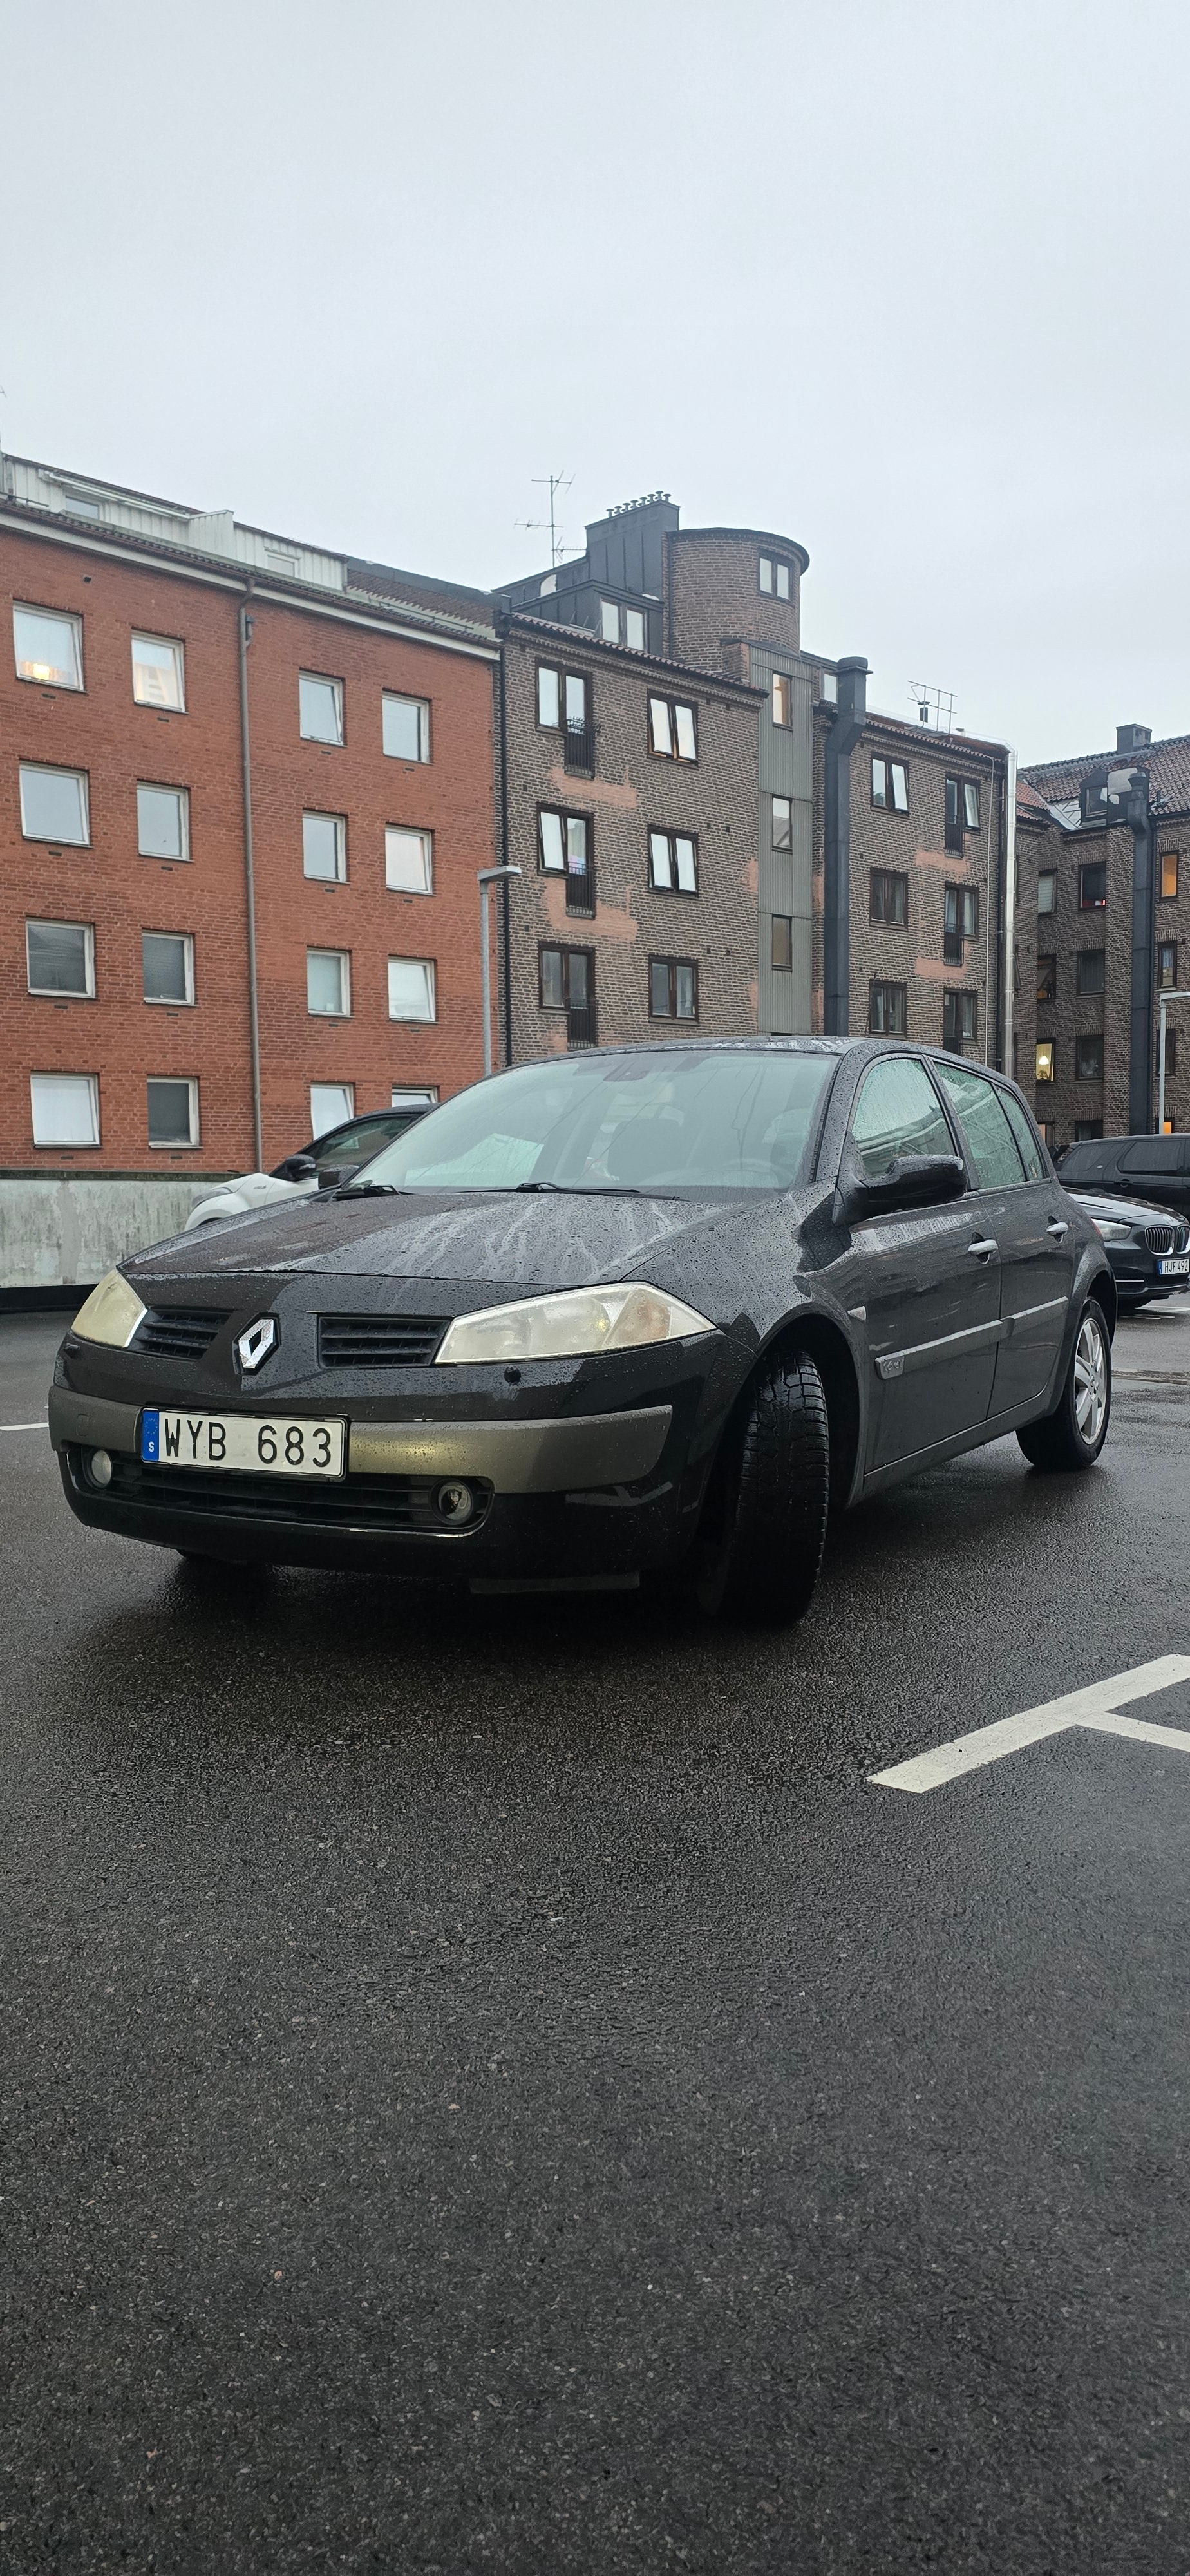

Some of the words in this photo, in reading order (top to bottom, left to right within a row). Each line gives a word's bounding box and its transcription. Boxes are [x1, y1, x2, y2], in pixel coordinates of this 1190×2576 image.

[1164, 1261, 1176, 1273] HJF
[1177, 1260, 1188, 1272] 492
[148, 1441, 155, 1452] S
[164, 1418, 226, 1461] WYB
[258, 1425, 331, 1468] 683
